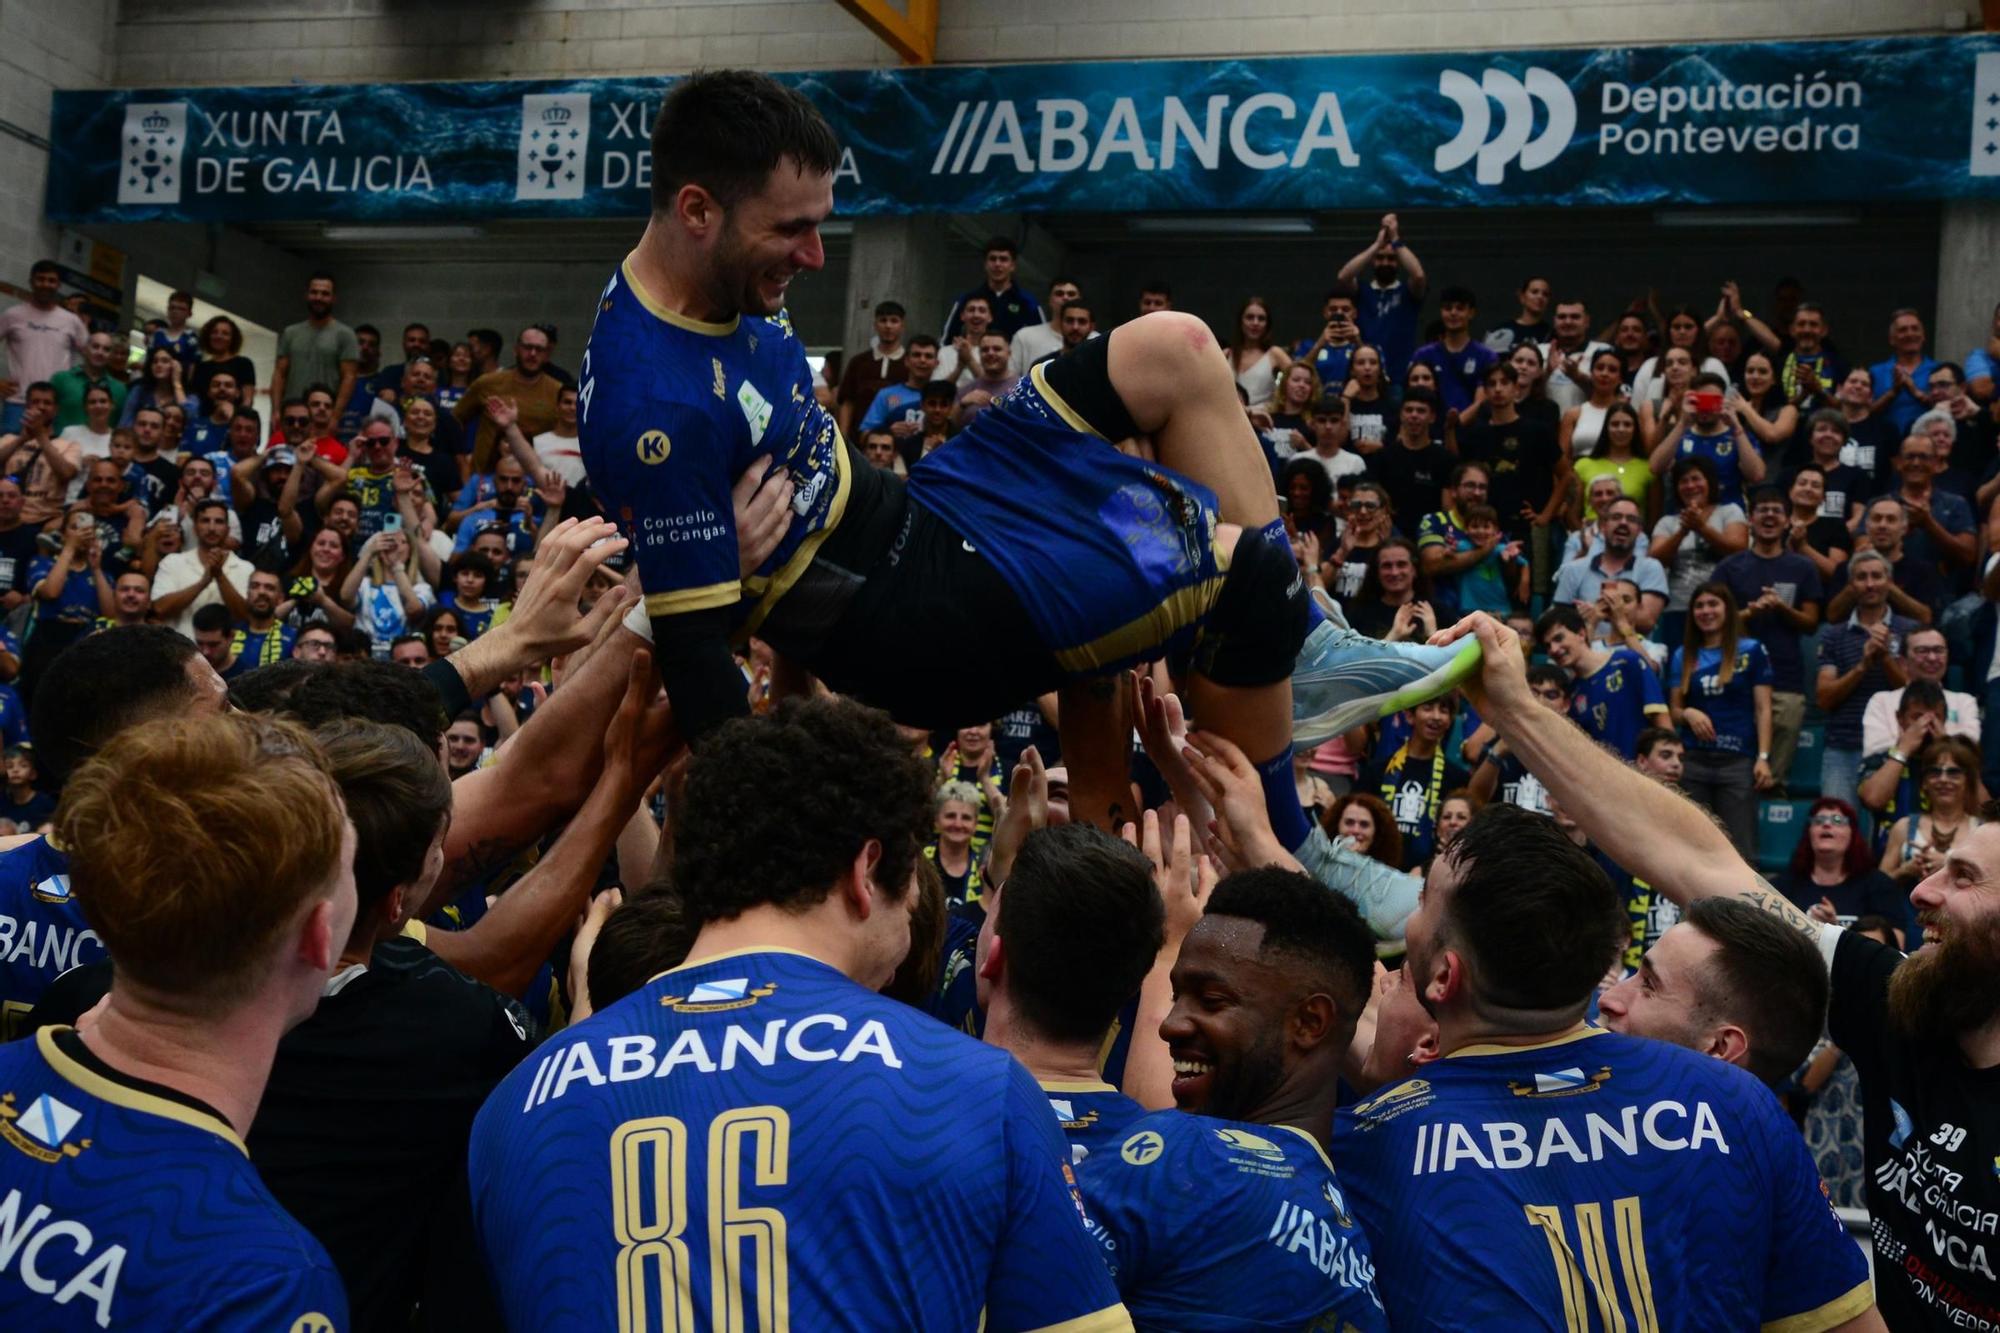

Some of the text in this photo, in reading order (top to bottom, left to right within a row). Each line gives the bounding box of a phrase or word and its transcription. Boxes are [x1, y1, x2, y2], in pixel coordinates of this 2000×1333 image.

[1601, 70, 1863, 123] Deputación
[202, 110, 345, 147] XUNTA
[1598, 115, 1861, 156] Pontevedra
[195, 155, 434, 194] DE GALICIA
[643, 509, 716, 530] Concello
[646, 523, 727, 547] de Cangas
[1929, 1122, 1968, 1153] 39
[609, 1105, 790, 1333] 86
[1923, 1184, 2000, 1236] GALICIA
[1086, 1218, 1117, 1251] ello
